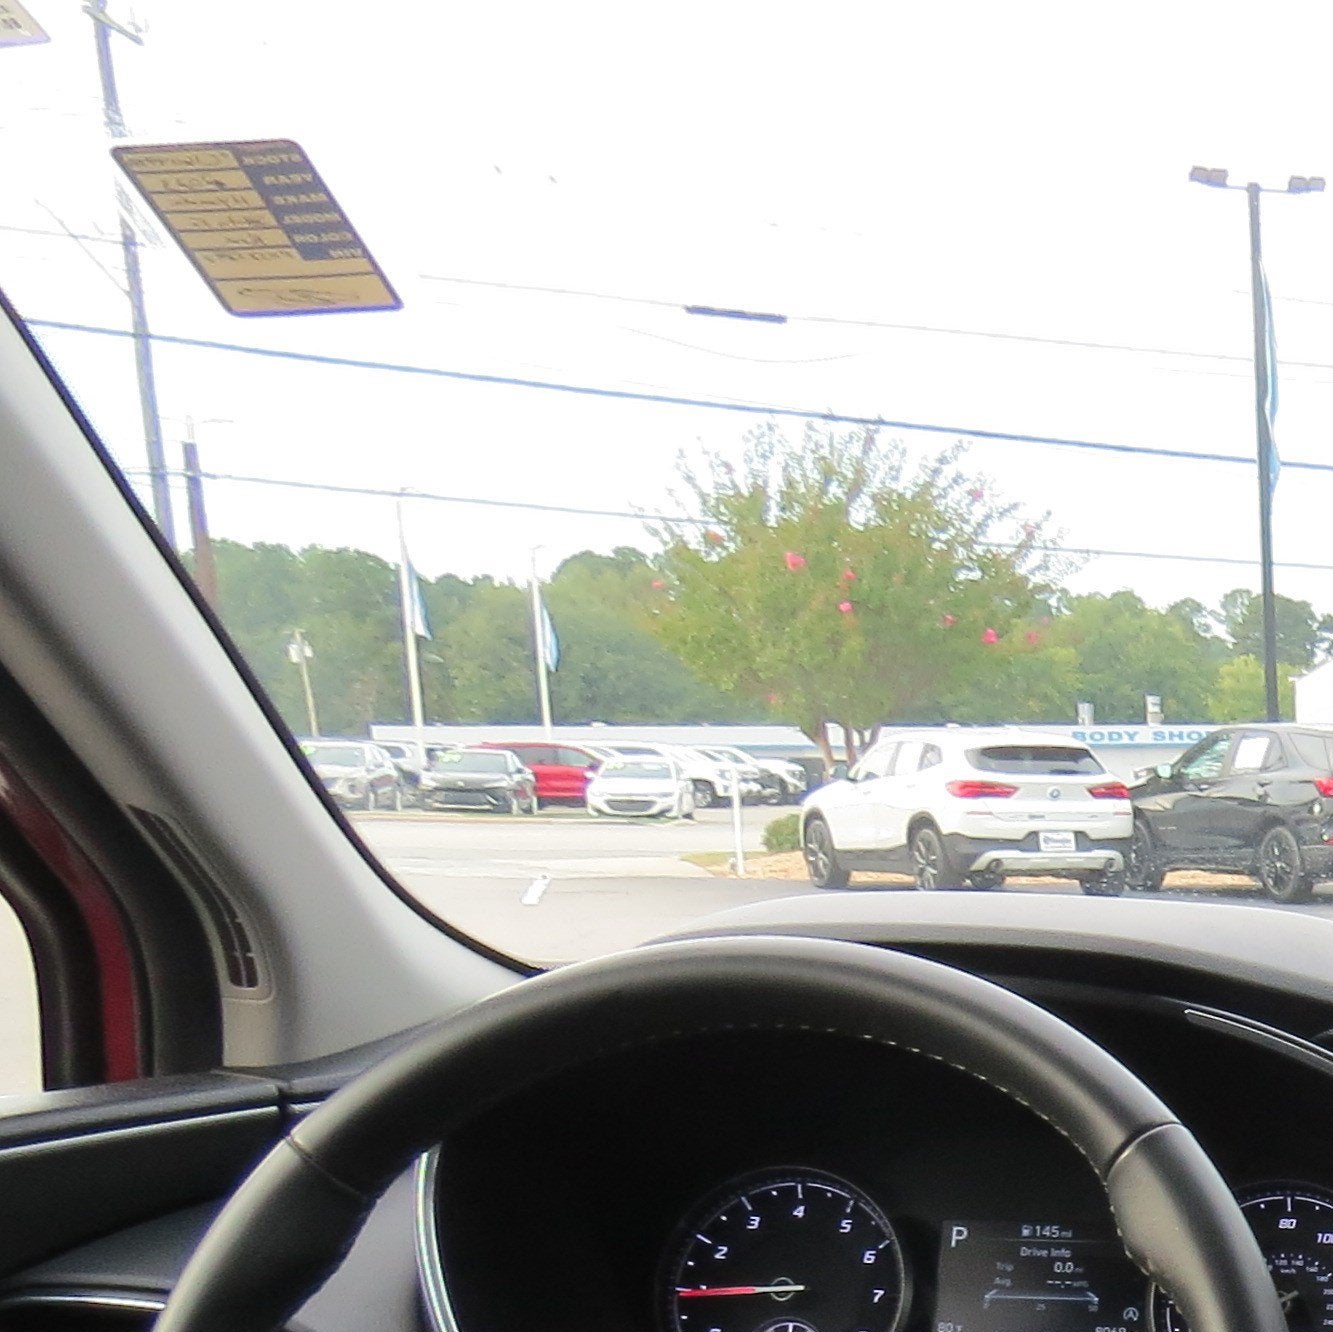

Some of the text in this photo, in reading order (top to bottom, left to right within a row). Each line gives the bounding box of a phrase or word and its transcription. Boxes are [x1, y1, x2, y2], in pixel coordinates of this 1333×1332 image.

[1072, 730, 1208, 742] BODY SHO
[793, 1205, 805, 1218] 4
[746, 1215, 761, 1229] 3
[839, 1219, 853, 1233] 5
[1278, 1218, 1297, 1229] 80
[951, 1226, 968, 1248] P
[714, 1246, 729, 1260] 2
[863, 1250, 877, 1264] 6
[1019, 1247, 1072, 1258] Drive Info
[1054, 1261, 1074, 1273] 0.0
[873, 1289, 885, 1303] 7
